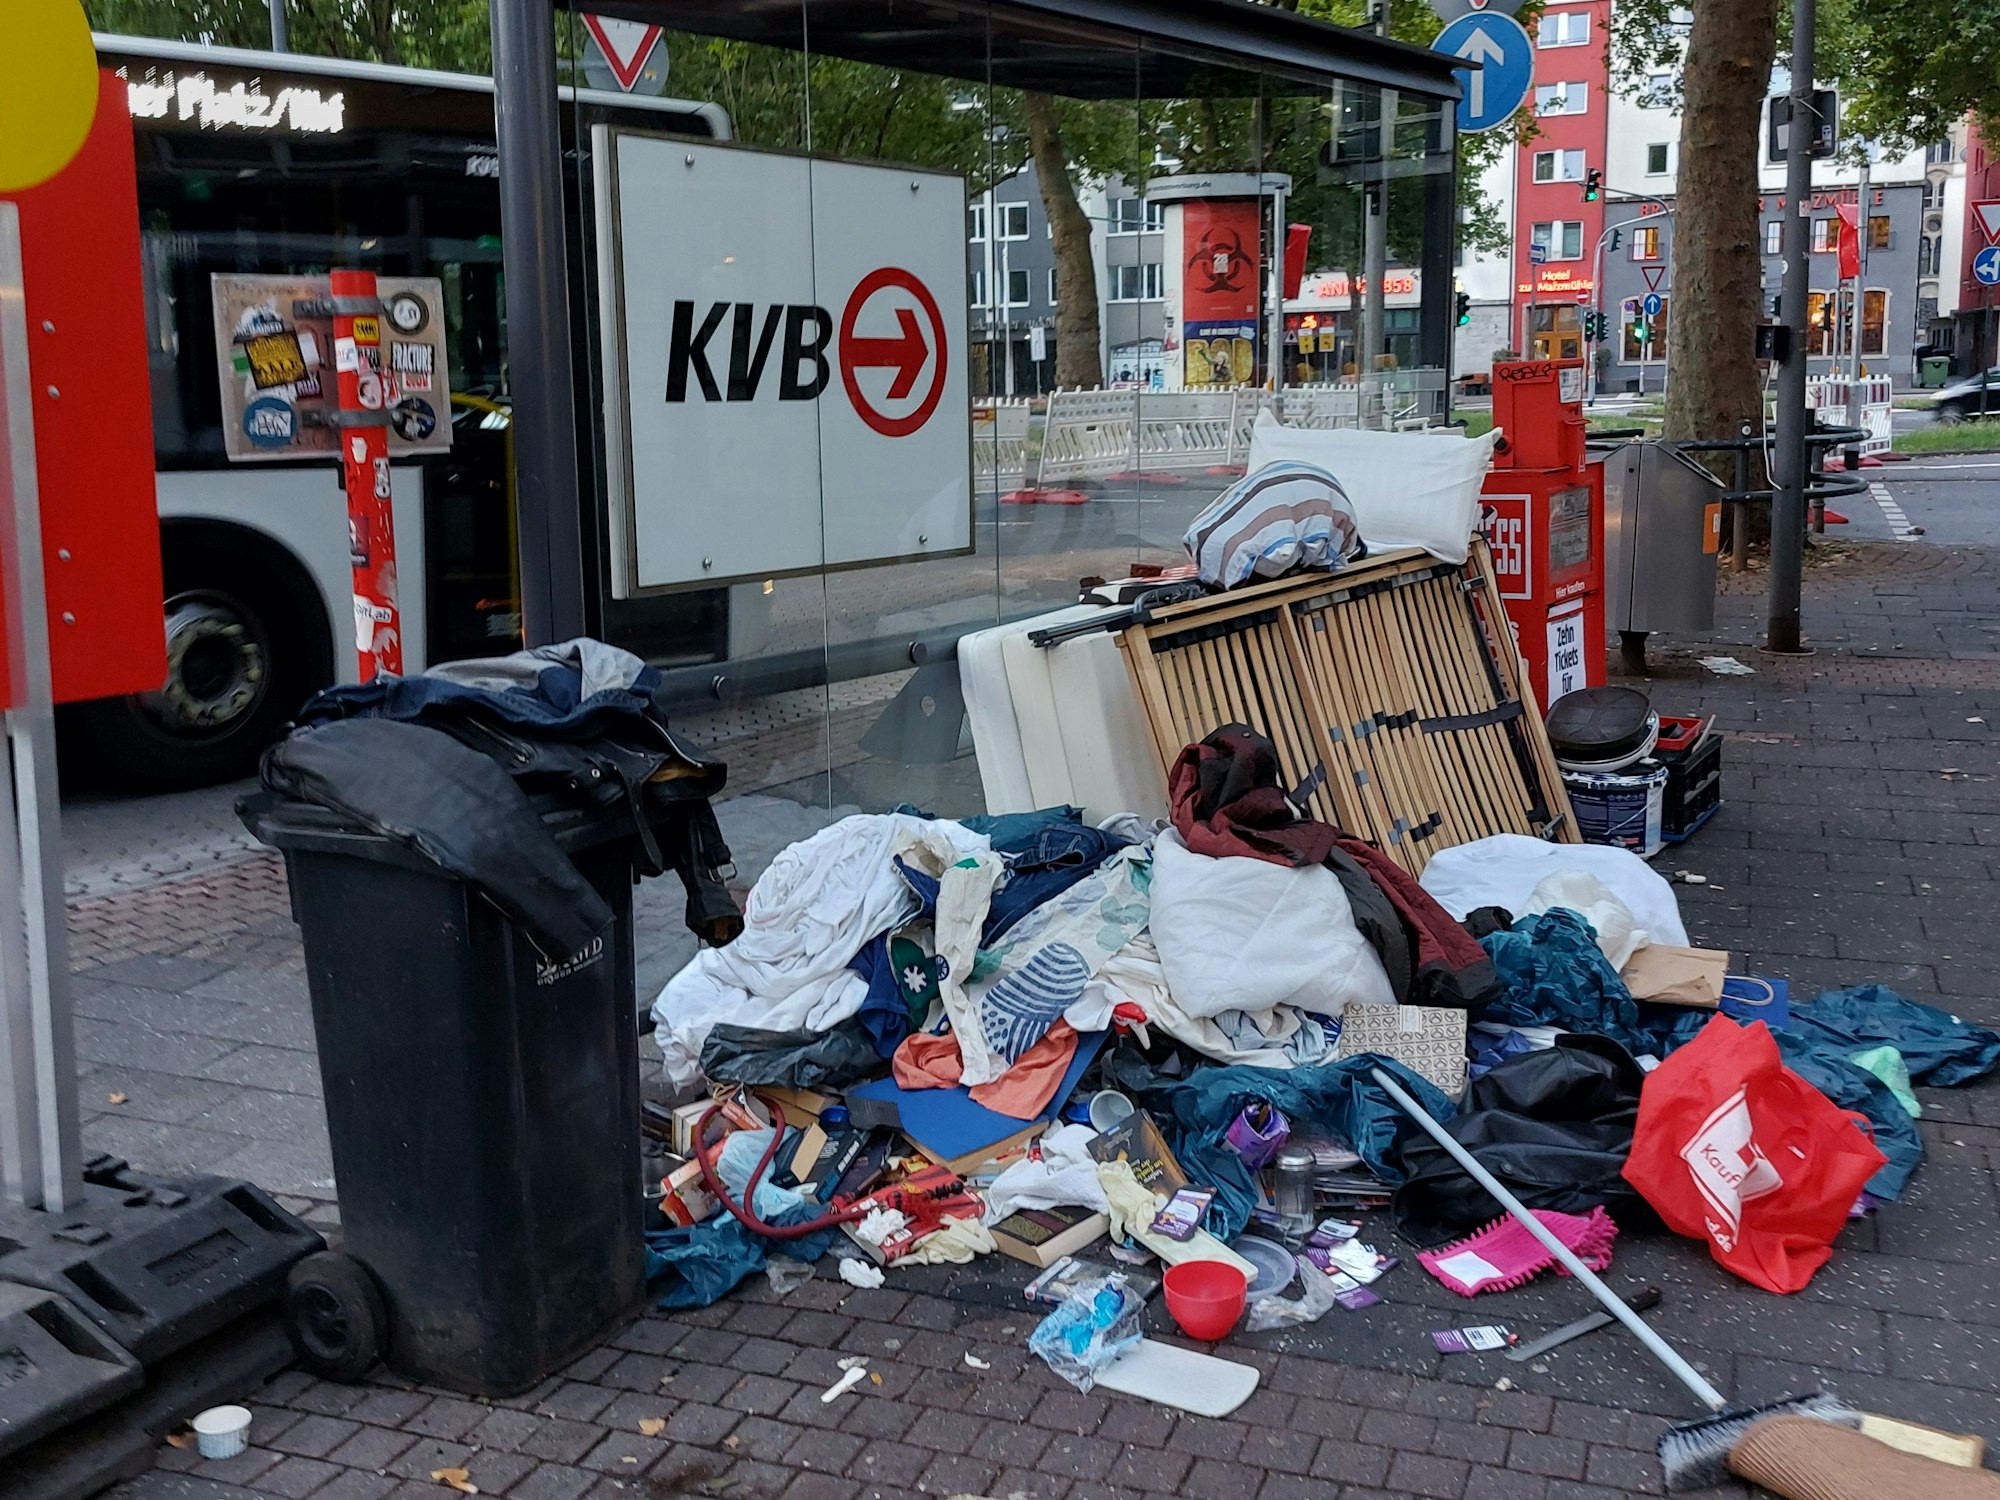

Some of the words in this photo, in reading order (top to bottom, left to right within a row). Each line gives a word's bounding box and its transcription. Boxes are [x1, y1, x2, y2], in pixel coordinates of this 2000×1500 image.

[1536, 280, 1594, 292] Malzmühle
[1542, 270, 1570, 280] Hotel
[392, 343, 432, 372] FRACTURE
[665, 300, 833, 402] KVB
[1557, 623, 1574, 648] Zehn
[1554, 648, 1579, 673] Tickets
[1562, 672, 1574, 695] für
